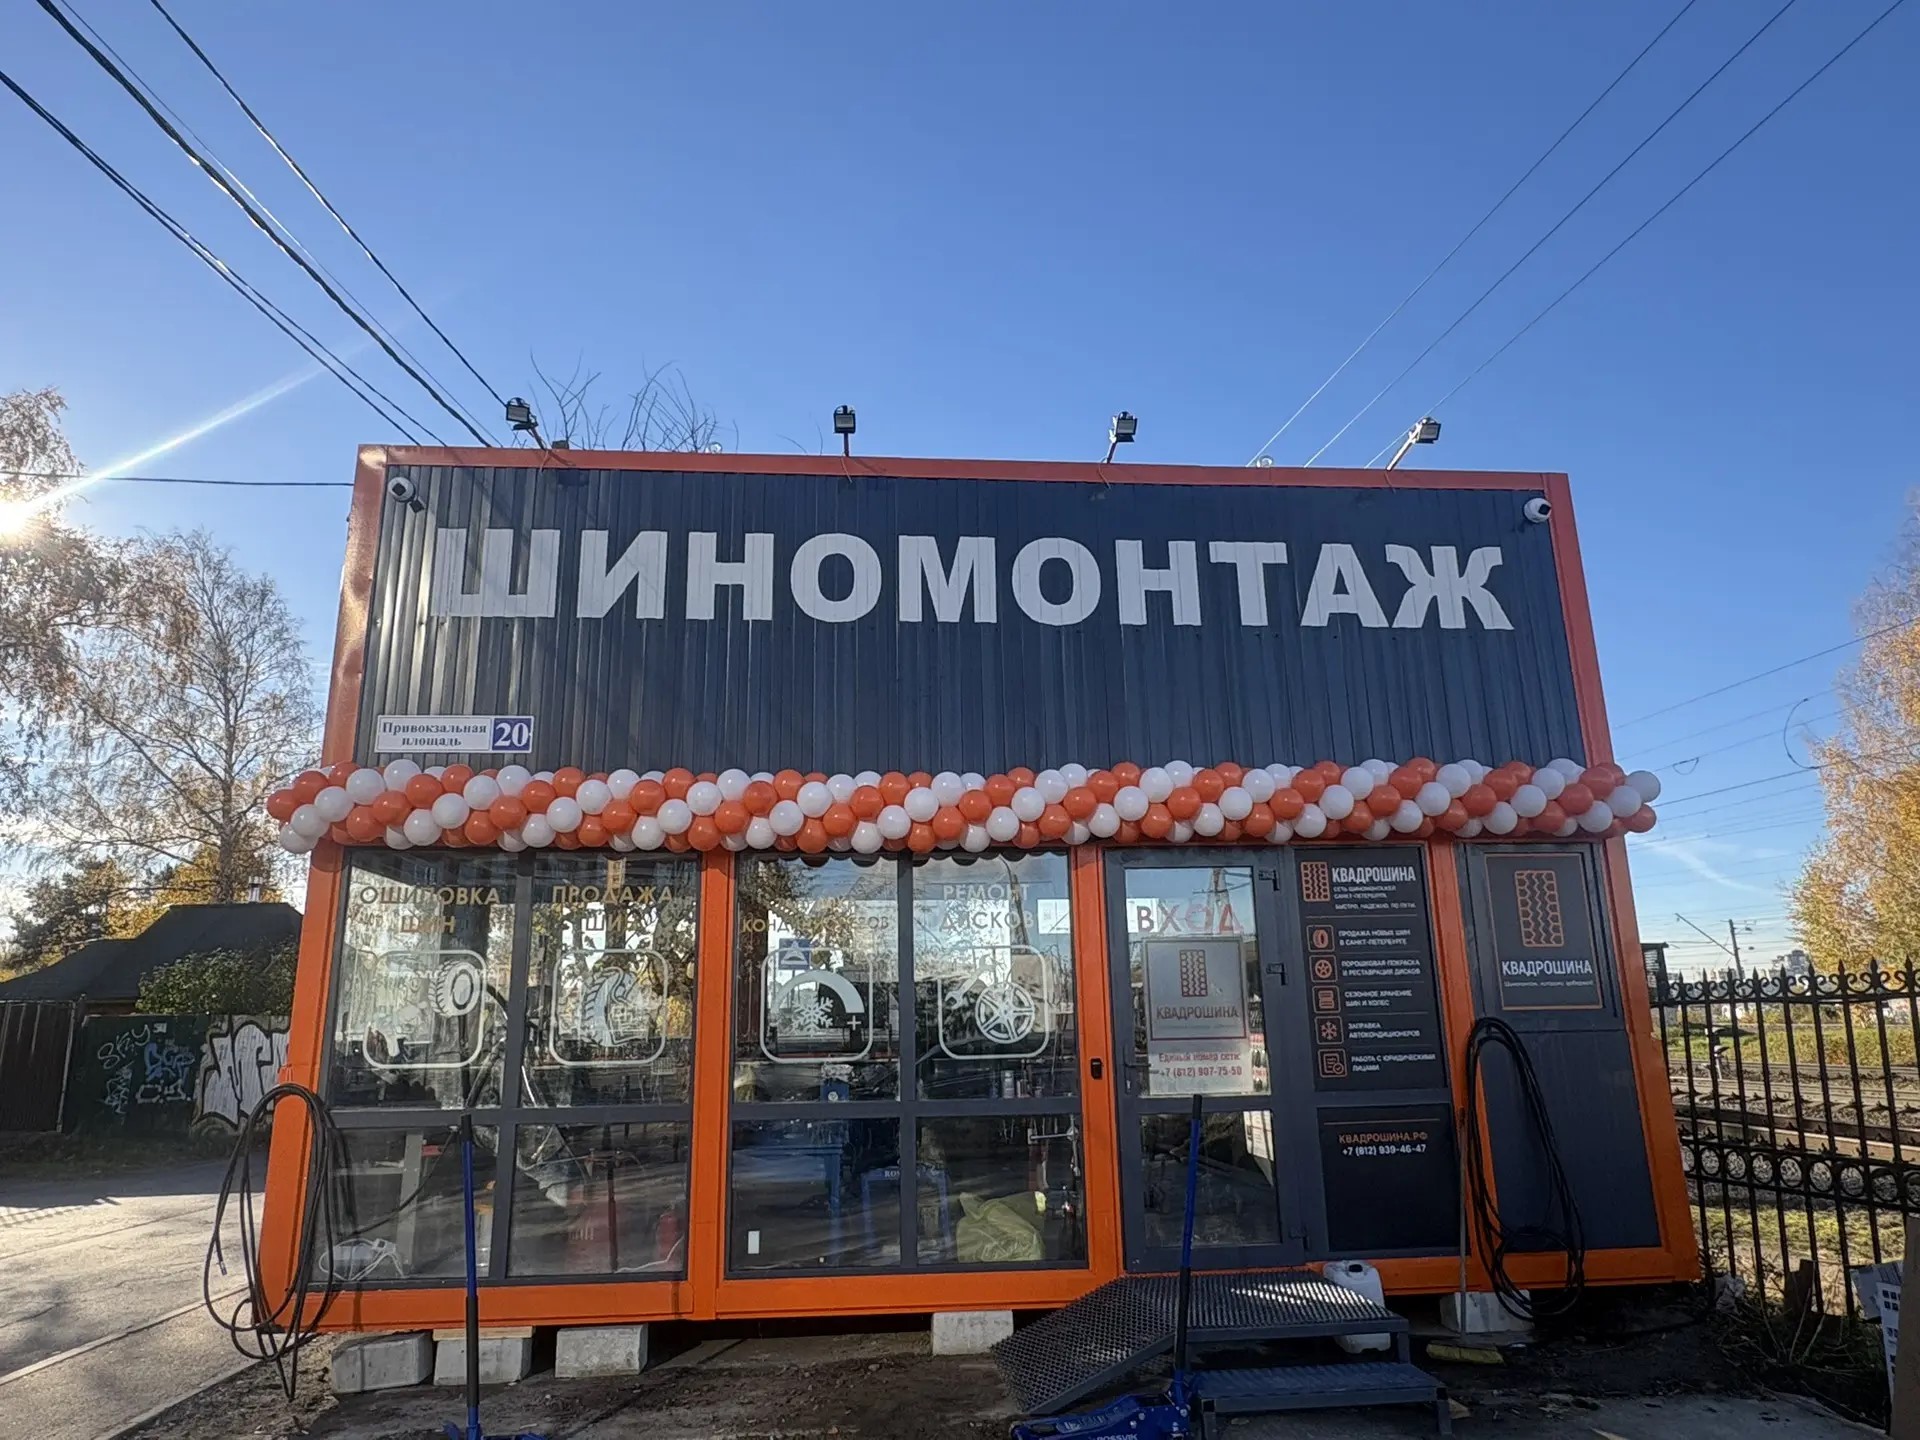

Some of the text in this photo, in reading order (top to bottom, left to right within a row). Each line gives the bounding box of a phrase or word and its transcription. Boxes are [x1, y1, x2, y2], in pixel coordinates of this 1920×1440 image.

[430, 527, 1514, 632] ШИНОМОНТАЖ
[382, 722, 487, 735] Привокзальная
[494, 722, 529, 747] 20
[401, 736, 462, 747] площадь
[1331, 866, 1417, 884] КВАДРОШИНА
[360, 886, 501, 905] ОШИПОВКА
[552, 885, 673, 904] ПРОДАЖА
[943, 884, 1030, 900] РЕМОНТ
[586, 911, 638, 931] ШИ
[939, 910, 1035, 932] ДИСКОВ
[1136, 903, 1245, 935] ВХОД
[1338, 930, 1371, 938] ПРОДАЖА
[1501, 959, 1593, 977] КВАДРОШИНА
[1156, 1005, 1240, 1021] КВАДРОШИНА
[1348, 1022, 1381, 1030] ЗАПРАВКА
[1348, 1030, 1420, 1039] АВТОКОНДИЦИОНЕРОВ
[1159, 1052, 1191, 1063] Единый
[1193, 1052, 1219, 1063] номер
[1382, 1053, 1436, 1062] ЮРИДИЧЕСКИМИ
[1159, 1067, 1170, 1078] +7
[1172, 1067, 1196, 1079] (812)
[1198, 1066, 1243, 1076] 907-75-50
[1339, 1131, 1428, 1144] КВАДРОШИНА.РФ
[1342, 1144, 1427, 1156] +7 (812) 939-46-47
